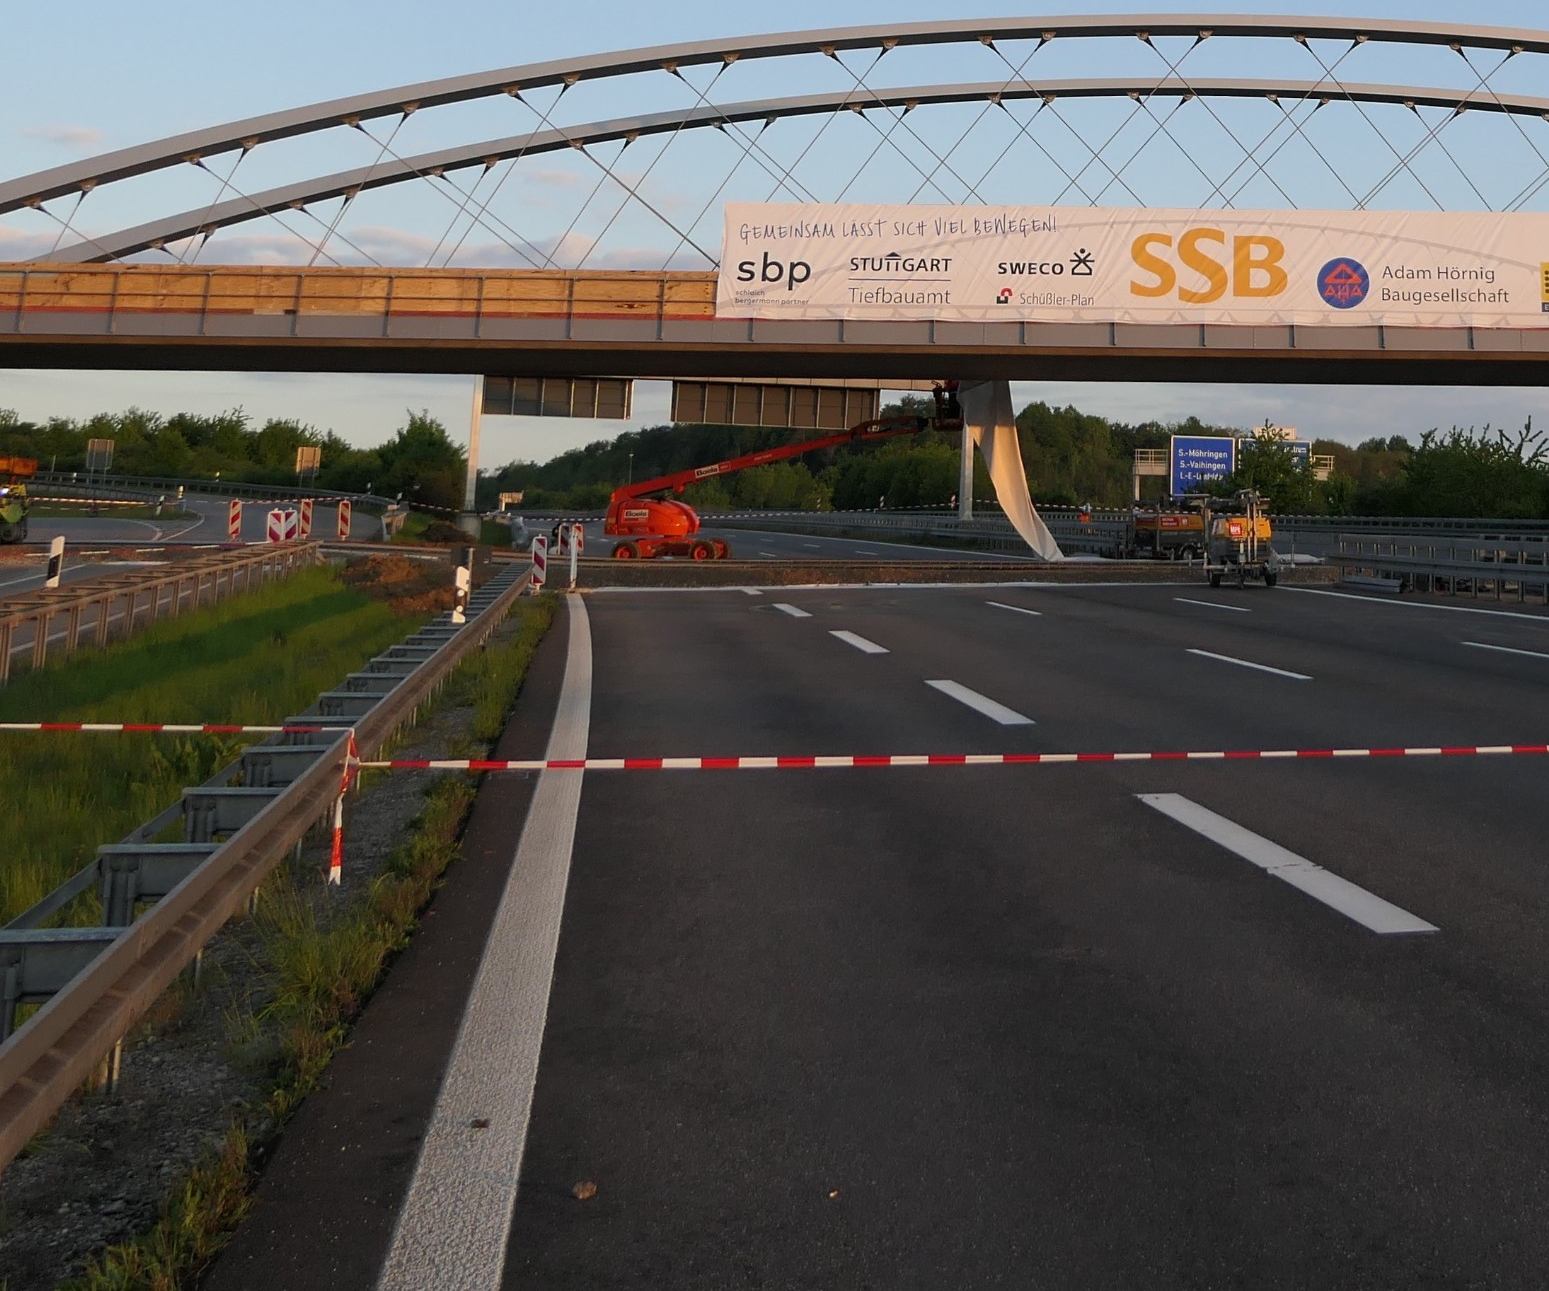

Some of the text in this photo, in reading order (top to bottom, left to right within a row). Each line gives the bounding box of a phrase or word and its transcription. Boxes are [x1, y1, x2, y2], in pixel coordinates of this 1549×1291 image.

[740, 213, 1057, 245] GEMEINSAM LÄSST SICH VIEL BEWEGEN!
[737, 251, 811, 291] sbp
[850, 253, 952, 272] STUTTGART
[998, 262, 1064, 275] SWECO
[1130, 227, 1288, 304] SSB
[1382, 265, 1495, 284] Adam Hörnig
[735, 298, 810, 306] bergermann partner
[848, 287, 951, 305] Tiefbauamt
[1020, 292, 1095, 306] Schüßler-Plan
[1381, 288, 1510, 306] Baugesellschaft
[1178, 449, 1228, 460] S.-Möhringen
[1180, 460, 1226, 470] S.-Vaihingen
